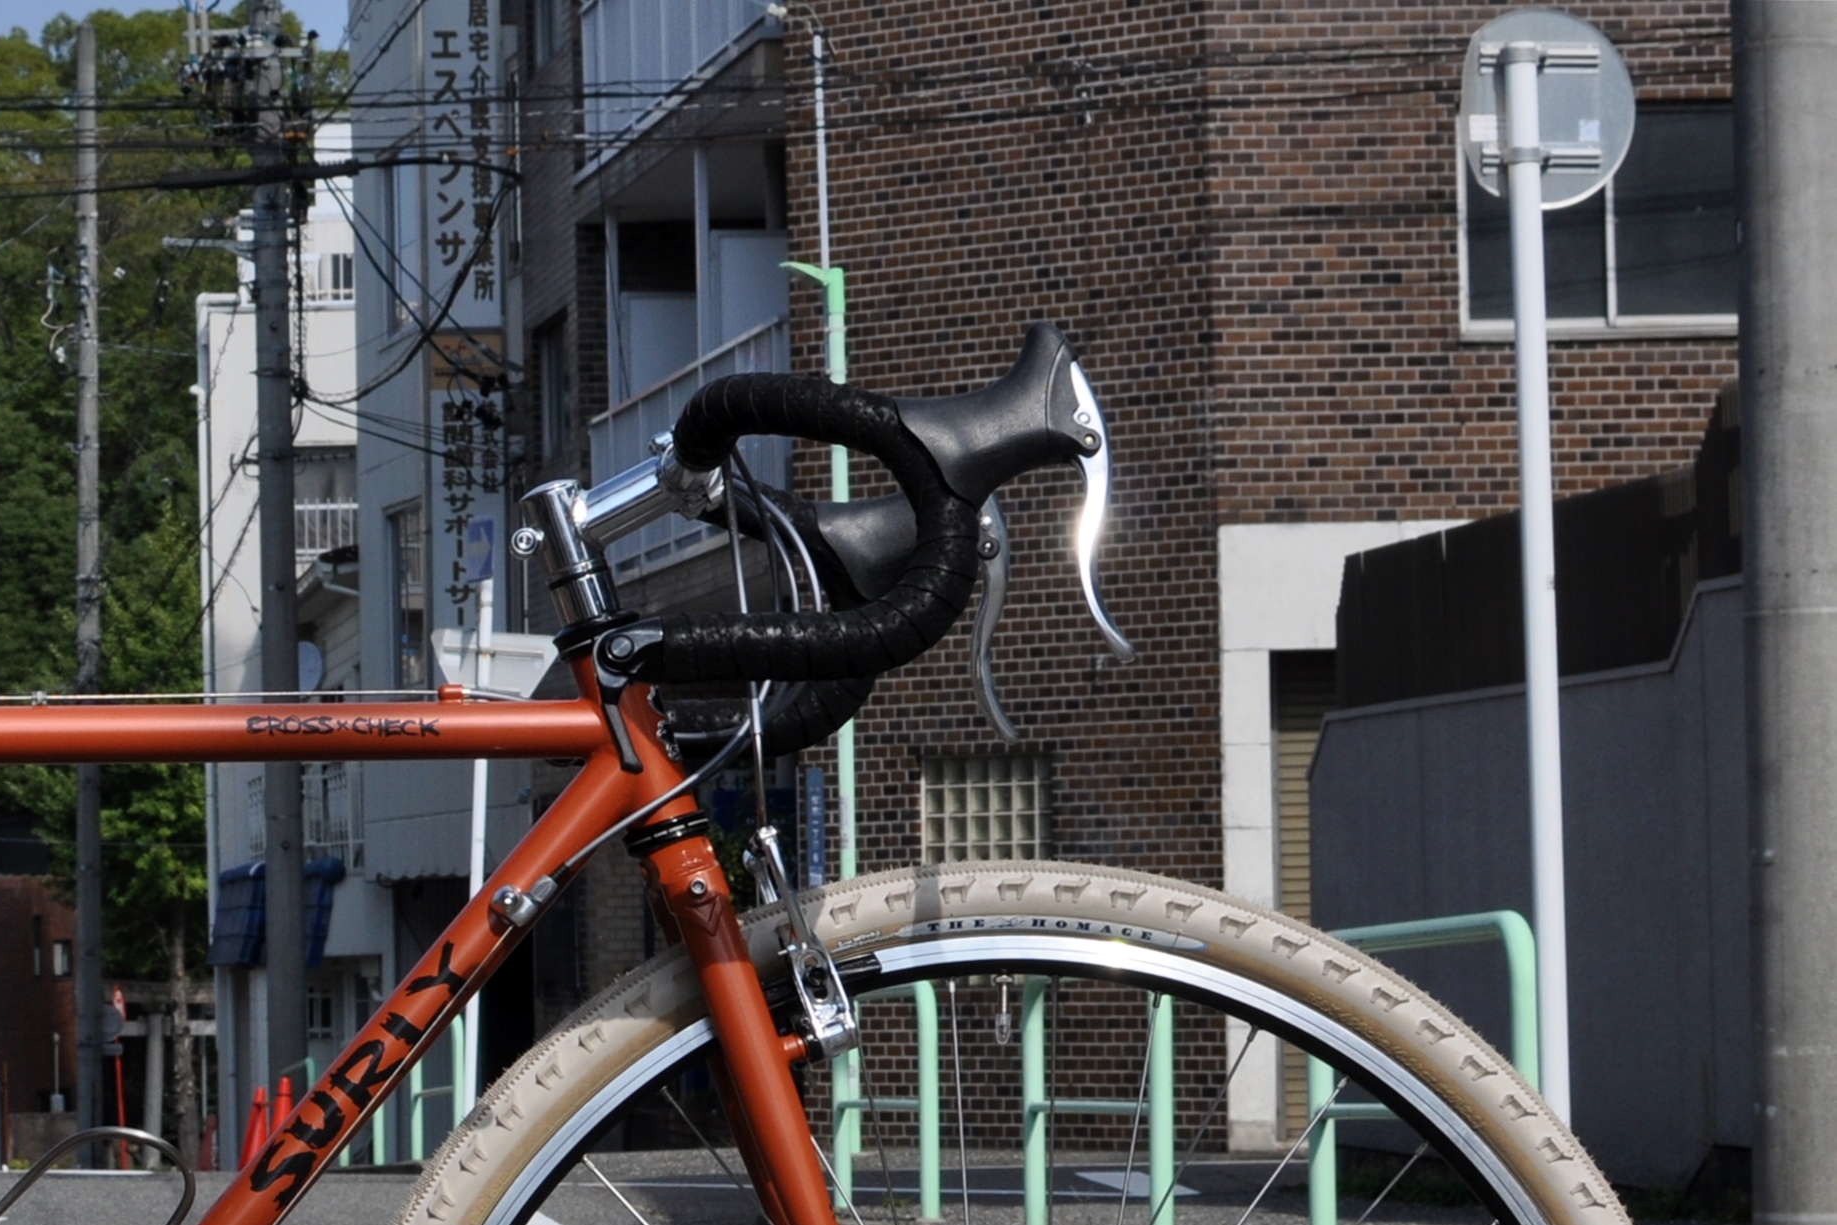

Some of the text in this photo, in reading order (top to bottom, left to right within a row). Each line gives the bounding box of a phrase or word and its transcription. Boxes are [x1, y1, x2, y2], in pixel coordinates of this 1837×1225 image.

[431, 31, 466, 266] エスペランサ
[926, 917, 1154, 942] THE HOMAGE
[250, 940, 467, 1211] SURLY
